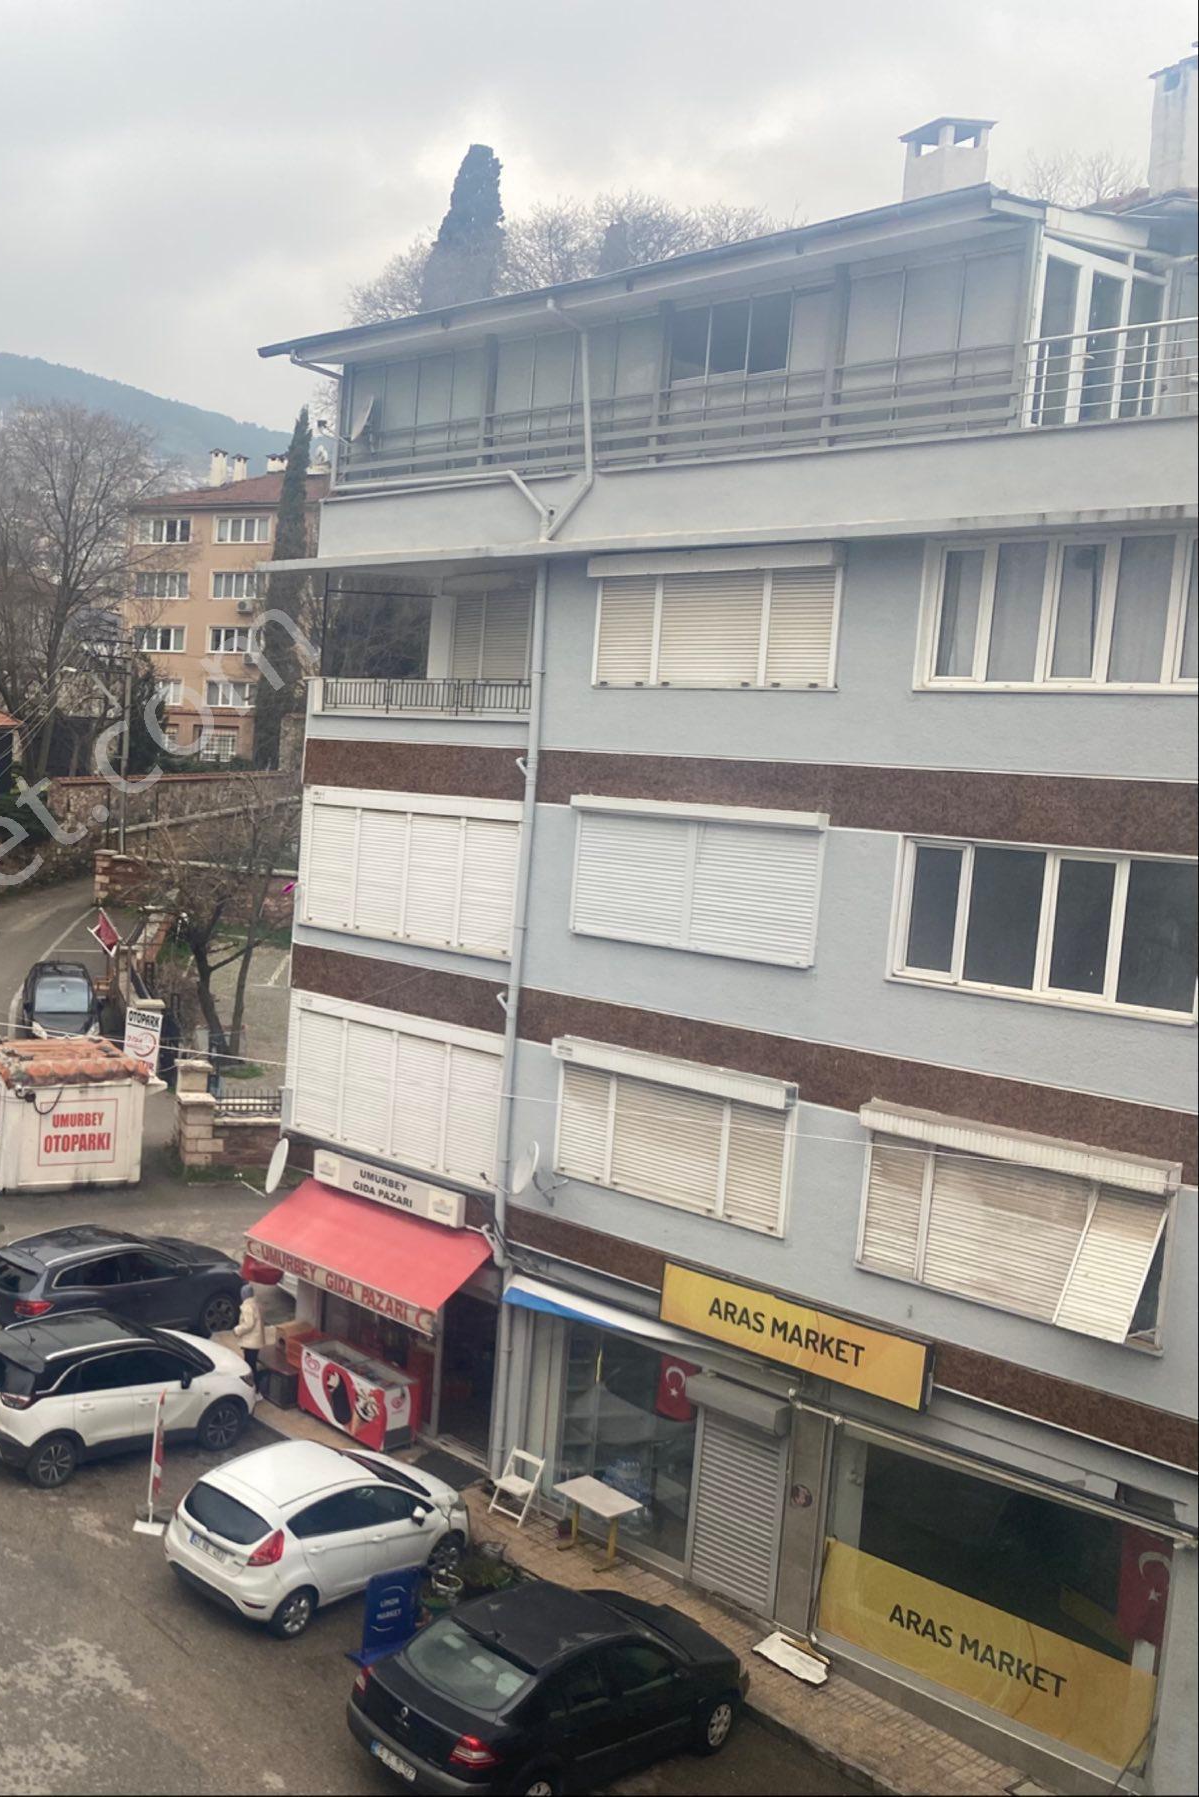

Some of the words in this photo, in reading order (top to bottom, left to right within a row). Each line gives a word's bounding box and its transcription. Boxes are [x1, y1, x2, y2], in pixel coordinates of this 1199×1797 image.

[128, 1010, 160, 1028] OTOPARK
[52, 1112, 104, 1128] UMURBEY
[44, 1133, 111, 1153] OTOPARKI
[359, 1169, 408, 1192] UMURBEY
[352, 1181, 376, 1196] GIDA
[378, 1189, 413, 1208] PAZARI
[261, 1245, 318, 1281] UMURBEY
[325, 1273, 354, 1297] GIDA
[361, 1286, 408, 1320] PAZARI
[708, 1297, 765, 1333] ARAS
[771, 1317, 865, 1367] MARKET
[889, 1604, 953, 1648] ARAS
[960, 1633, 1067, 1698] MARKET
